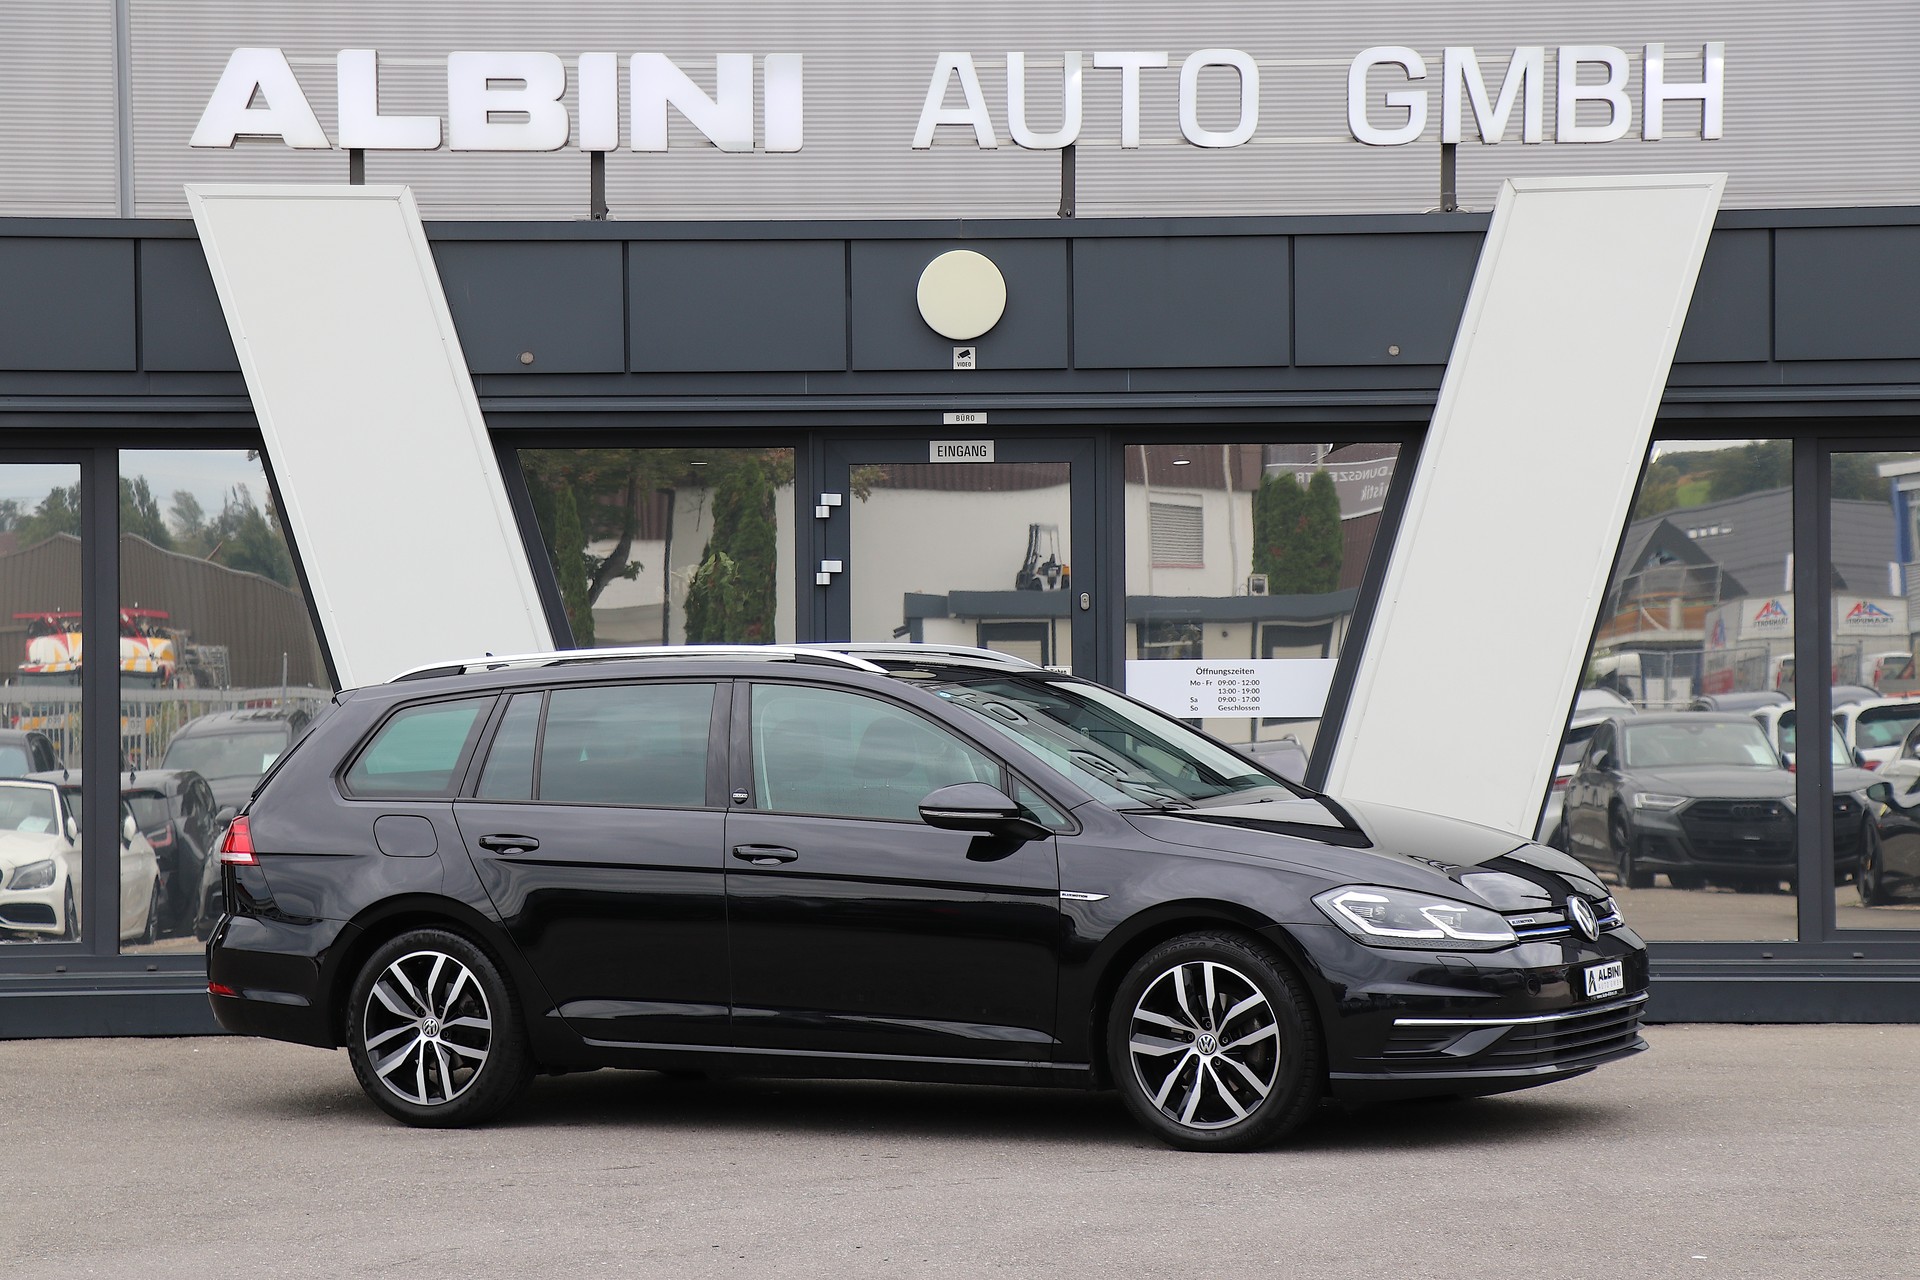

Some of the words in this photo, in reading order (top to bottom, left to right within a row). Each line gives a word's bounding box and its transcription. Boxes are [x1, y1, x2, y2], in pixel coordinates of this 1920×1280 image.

[189, 47, 803, 153] ALBINI
[912, 48, 1260, 150] AUTO
[1346, 41, 1725, 146] GMBH
[955, 414, 975, 422] BÜRO
[937, 445, 987, 457] EINGANG
[1196, 667, 1254, 676] Öffnungszeiten
[1598, 964, 1622, 982] ALBINI
